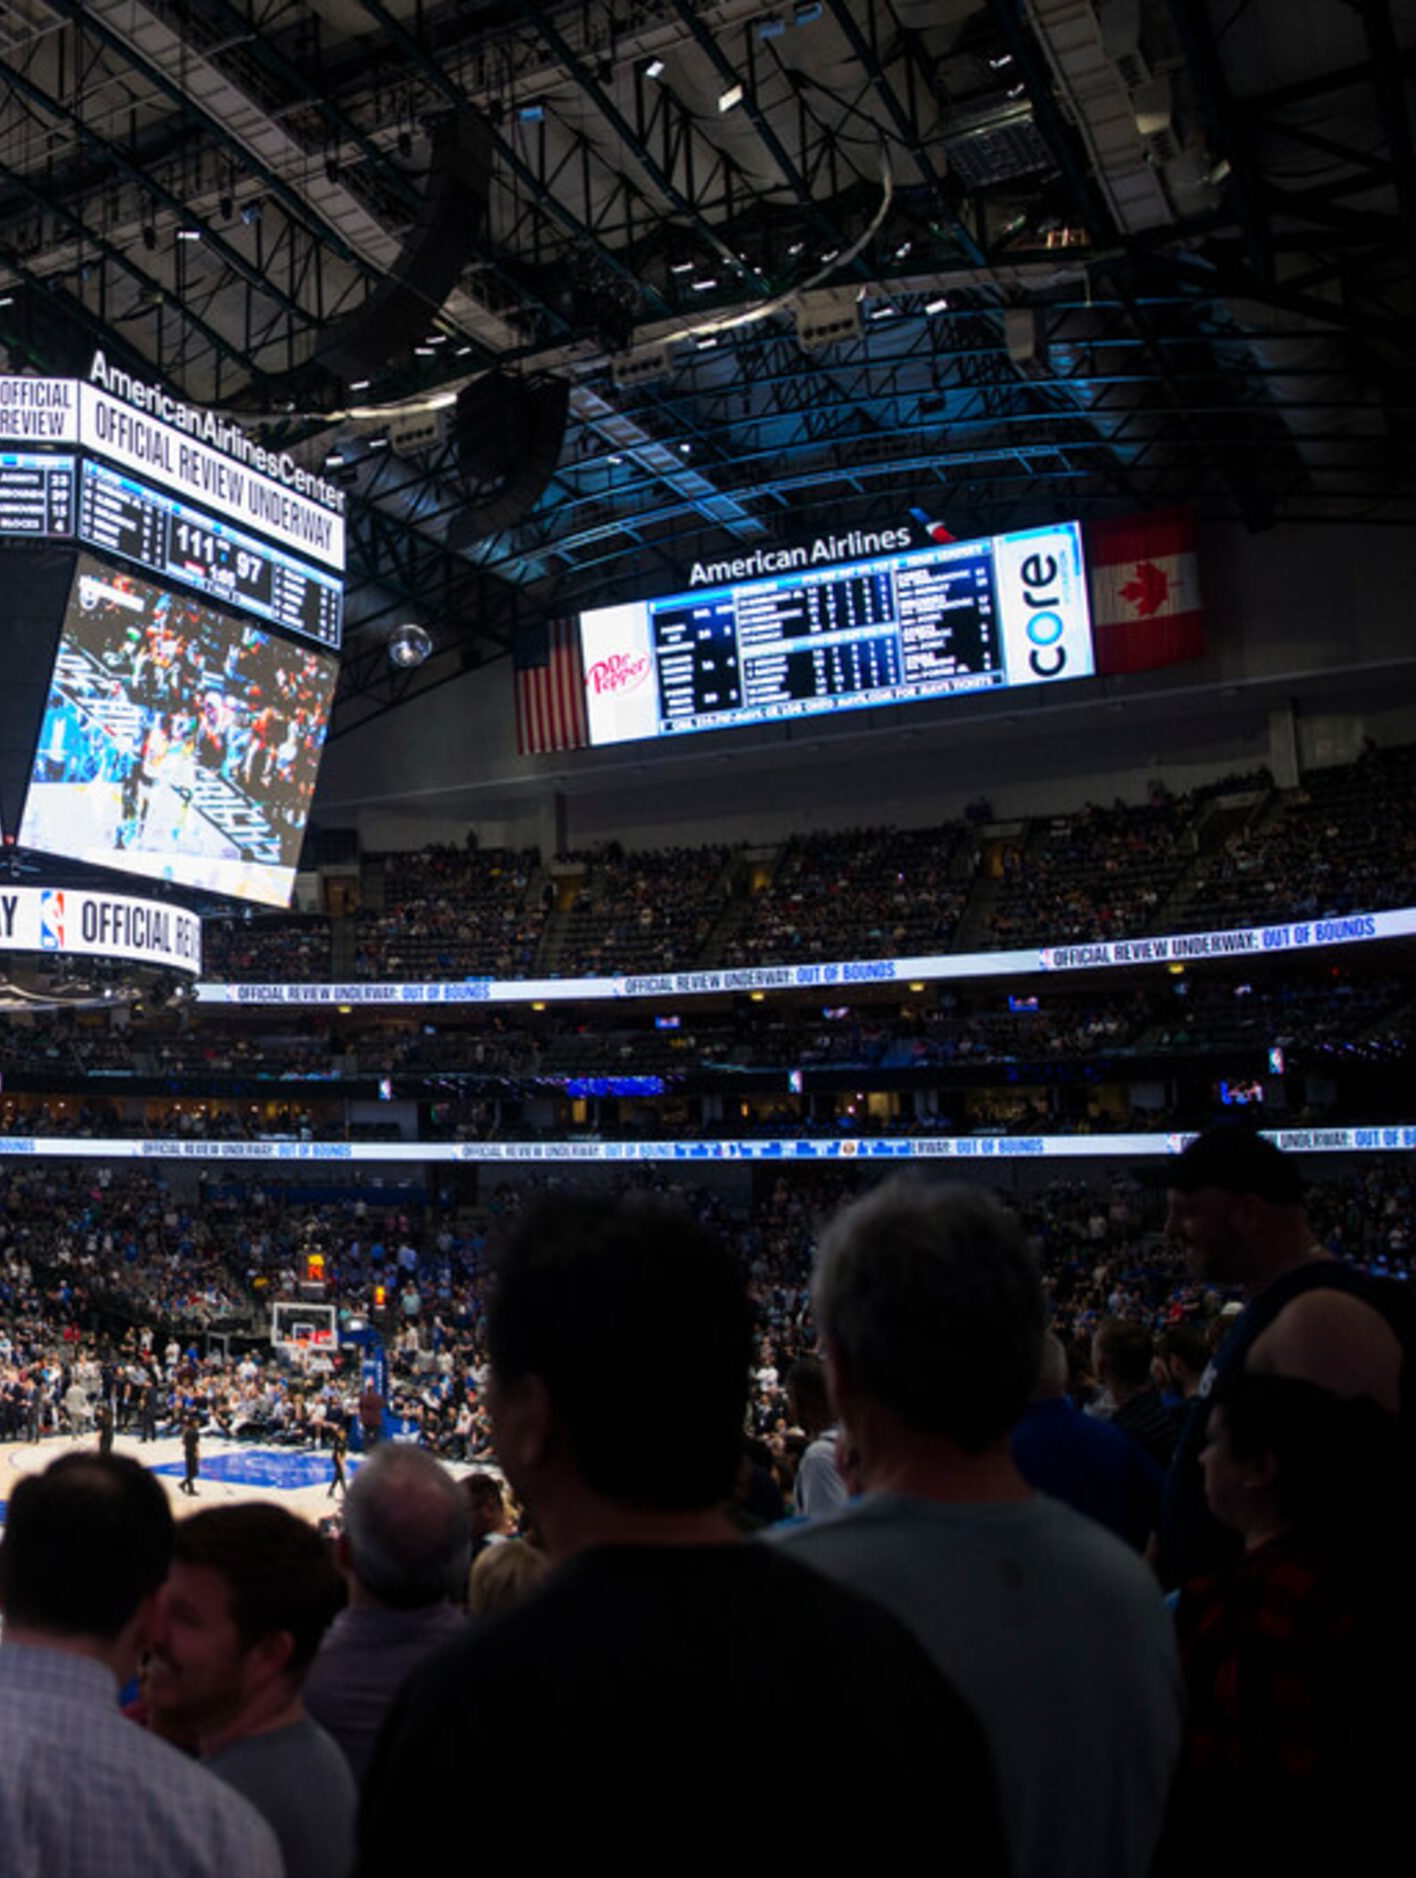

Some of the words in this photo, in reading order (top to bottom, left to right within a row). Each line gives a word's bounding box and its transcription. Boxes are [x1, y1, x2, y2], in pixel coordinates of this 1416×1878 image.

[0, 381, 72, 408] OFFICIAL
[0, 409, 64, 436] REVIEW
[96, 401, 174, 474] OFFICIAL
[179, 444, 245, 507] REVIEW
[248, 479, 332, 552] UNDERWAY
[176, 524, 214, 562] 111
[689, 546, 809, 587] American
[810, 526, 913, 564] Airlines
[236, 552, 263, 584] 97
[1020, 553, 1067, 678] core
[82, 899, 172, 953] OFFICIAL
[1053, 947, 1111, 967] OFFICIAL
[1114, 941, 1168, 961] REVIEW
[1171, 931, 1260, 956] UNDERWAY:
[1262, 929, 1290, 948] OUT
[1294, 926, 1312, 945] OF
[1316, 917, 1376, 942] BOUNDS
[238, 986, 283, 1000] OFFICIAL
[287, 987, 329, 1000] REVIEW
[402, 985, 423, 1000] OUT
[427, 986, 440, 1000] OF
[443, 984, 490, 1000] BOUNDS
[625, 976, 673, 994] OFFICIAL
[676, 973, 720, 991] REVIEW
[797, 966, 820, 984] OUT
[824, 964, 839, 983] OF
[843, 961, 895, 981] BOUNDS
[1355, 1130, 1380, 1147] OUT
[1383, 1129, 1399, 1146] OF
